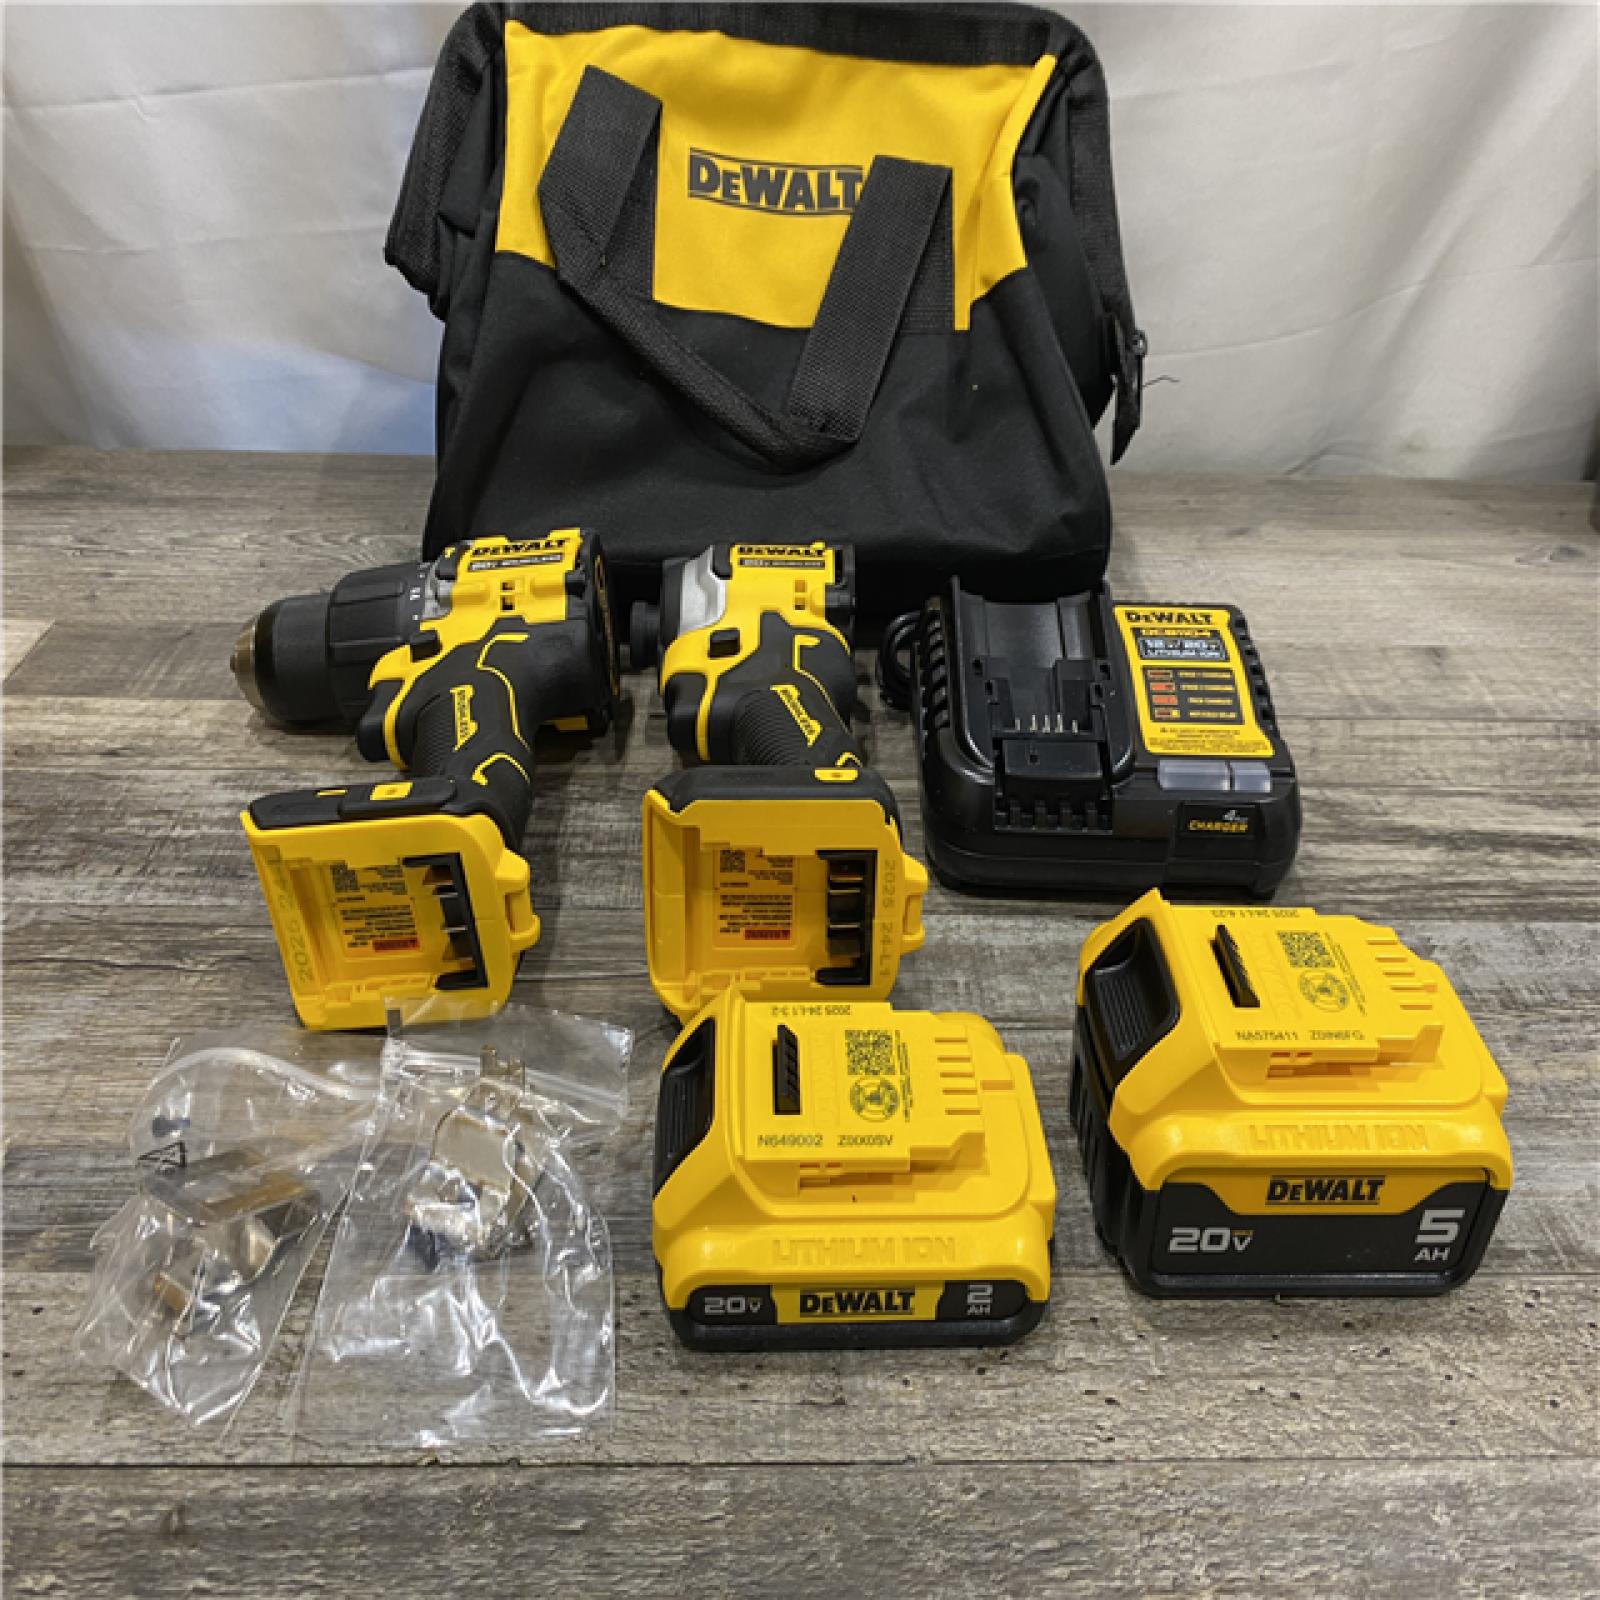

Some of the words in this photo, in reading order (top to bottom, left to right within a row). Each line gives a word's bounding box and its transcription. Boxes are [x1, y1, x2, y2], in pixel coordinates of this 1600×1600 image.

[688, 154, 863, 209] DEWALT
[472, 537, 569, 556] DEWALT
[1125, 610, 1213, 625] DEWALT
[1249, 1125, 1370, 1150] LITHIUM
[1373, 1125, 1430, 1150] ION
[1266, 1177, 1385, 1204] DEWALT
[1415, 1208, 1466, 1244] 5
[772, 1238, 895, 1265] LITHIUM
[901, 1237, 957, 1264] ION
[800, 1289, 915, 1315] DEWALT
[967, 1284, 993, 1303] 2
